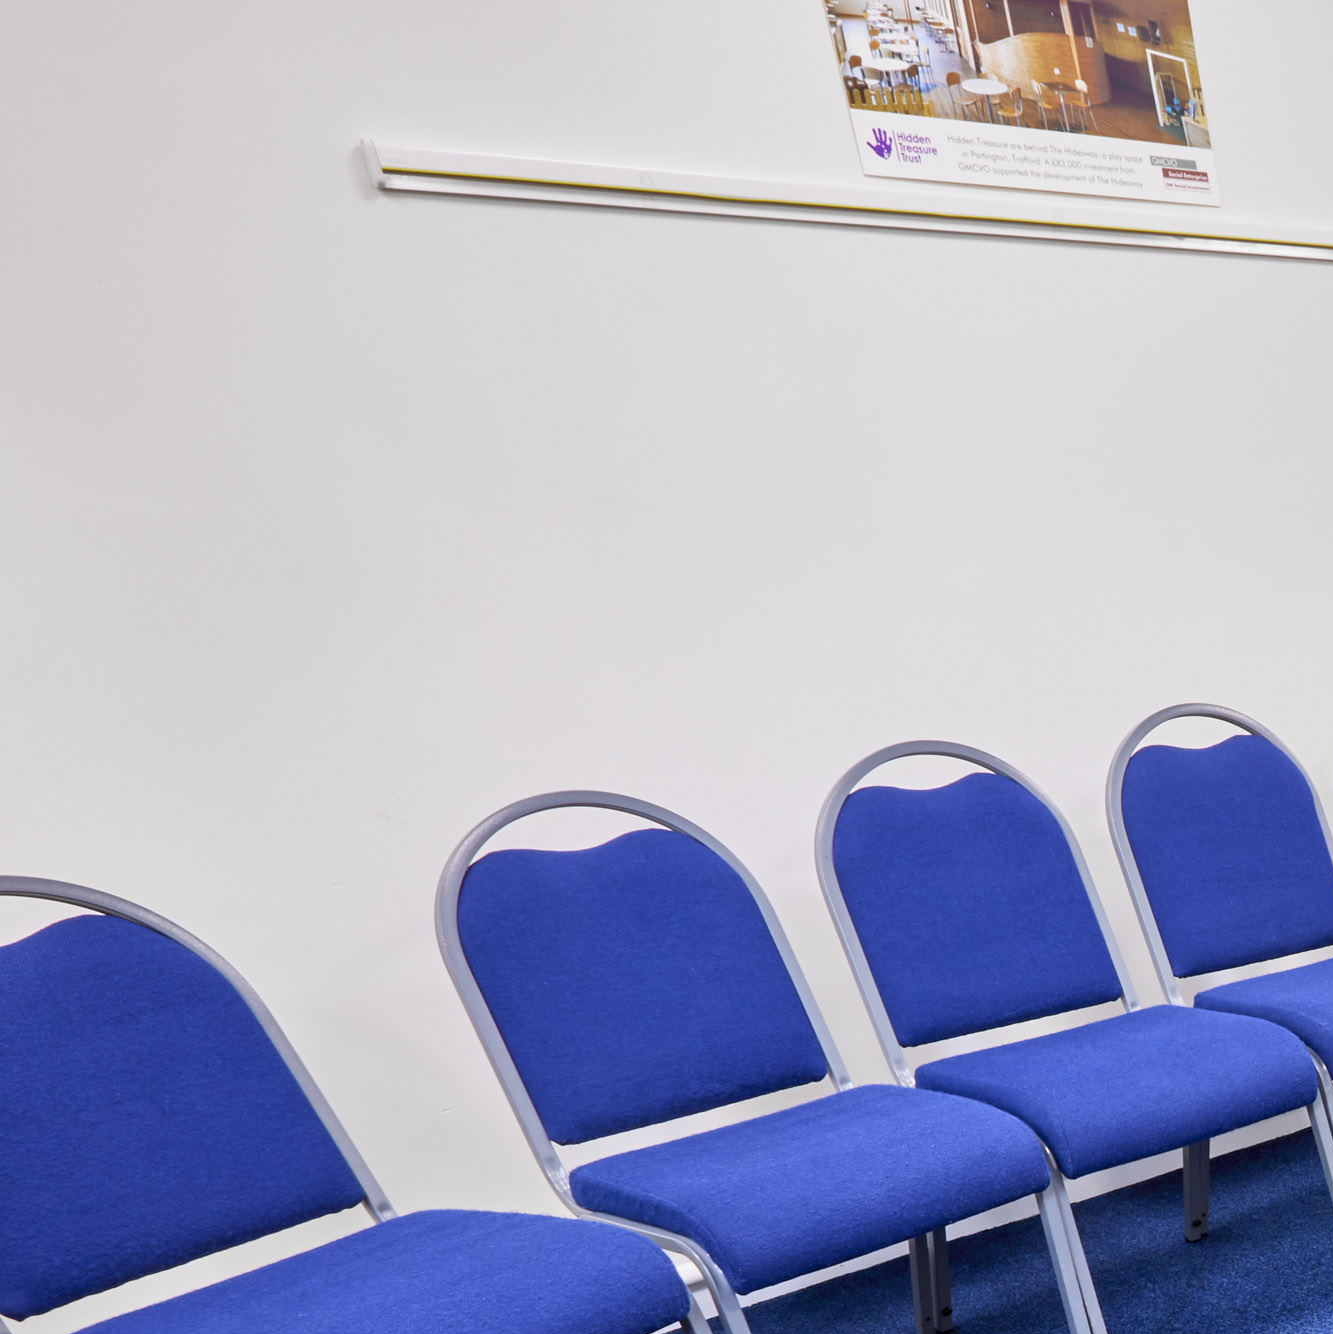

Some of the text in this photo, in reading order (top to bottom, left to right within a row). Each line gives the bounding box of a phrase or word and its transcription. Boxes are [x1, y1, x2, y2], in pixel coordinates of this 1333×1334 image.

[896, 131, 931, 144] Hidden
[898, 142, 938, 155] Treasure
[947, 135, 975, 145] Hidden
[976, 137, 1008, 149] Treasure
[1024, 144, 1048, 154] behind
[1050, 145, 1063, 154] The
[1108, 152, 1122, 161] play
[1124, 155, 1143, 164] space
[901, 152, 922, 163] Trust
[1044, 159, 1051, 167] A
[1083, 163, 1118, 173] investment
[1119, 166, 1136, 175] from
[958, 161, 991, 174] GMCVO
[993, 167, 1029, 178] supported
[1029, 170, 1042, 178] the
[1043, 171, 1087, 182] development
[1097, 175, 1110, 184] The
[1111, 177, 1144, 190] Hideaway
[1168, 170, 1183, 179] Social
